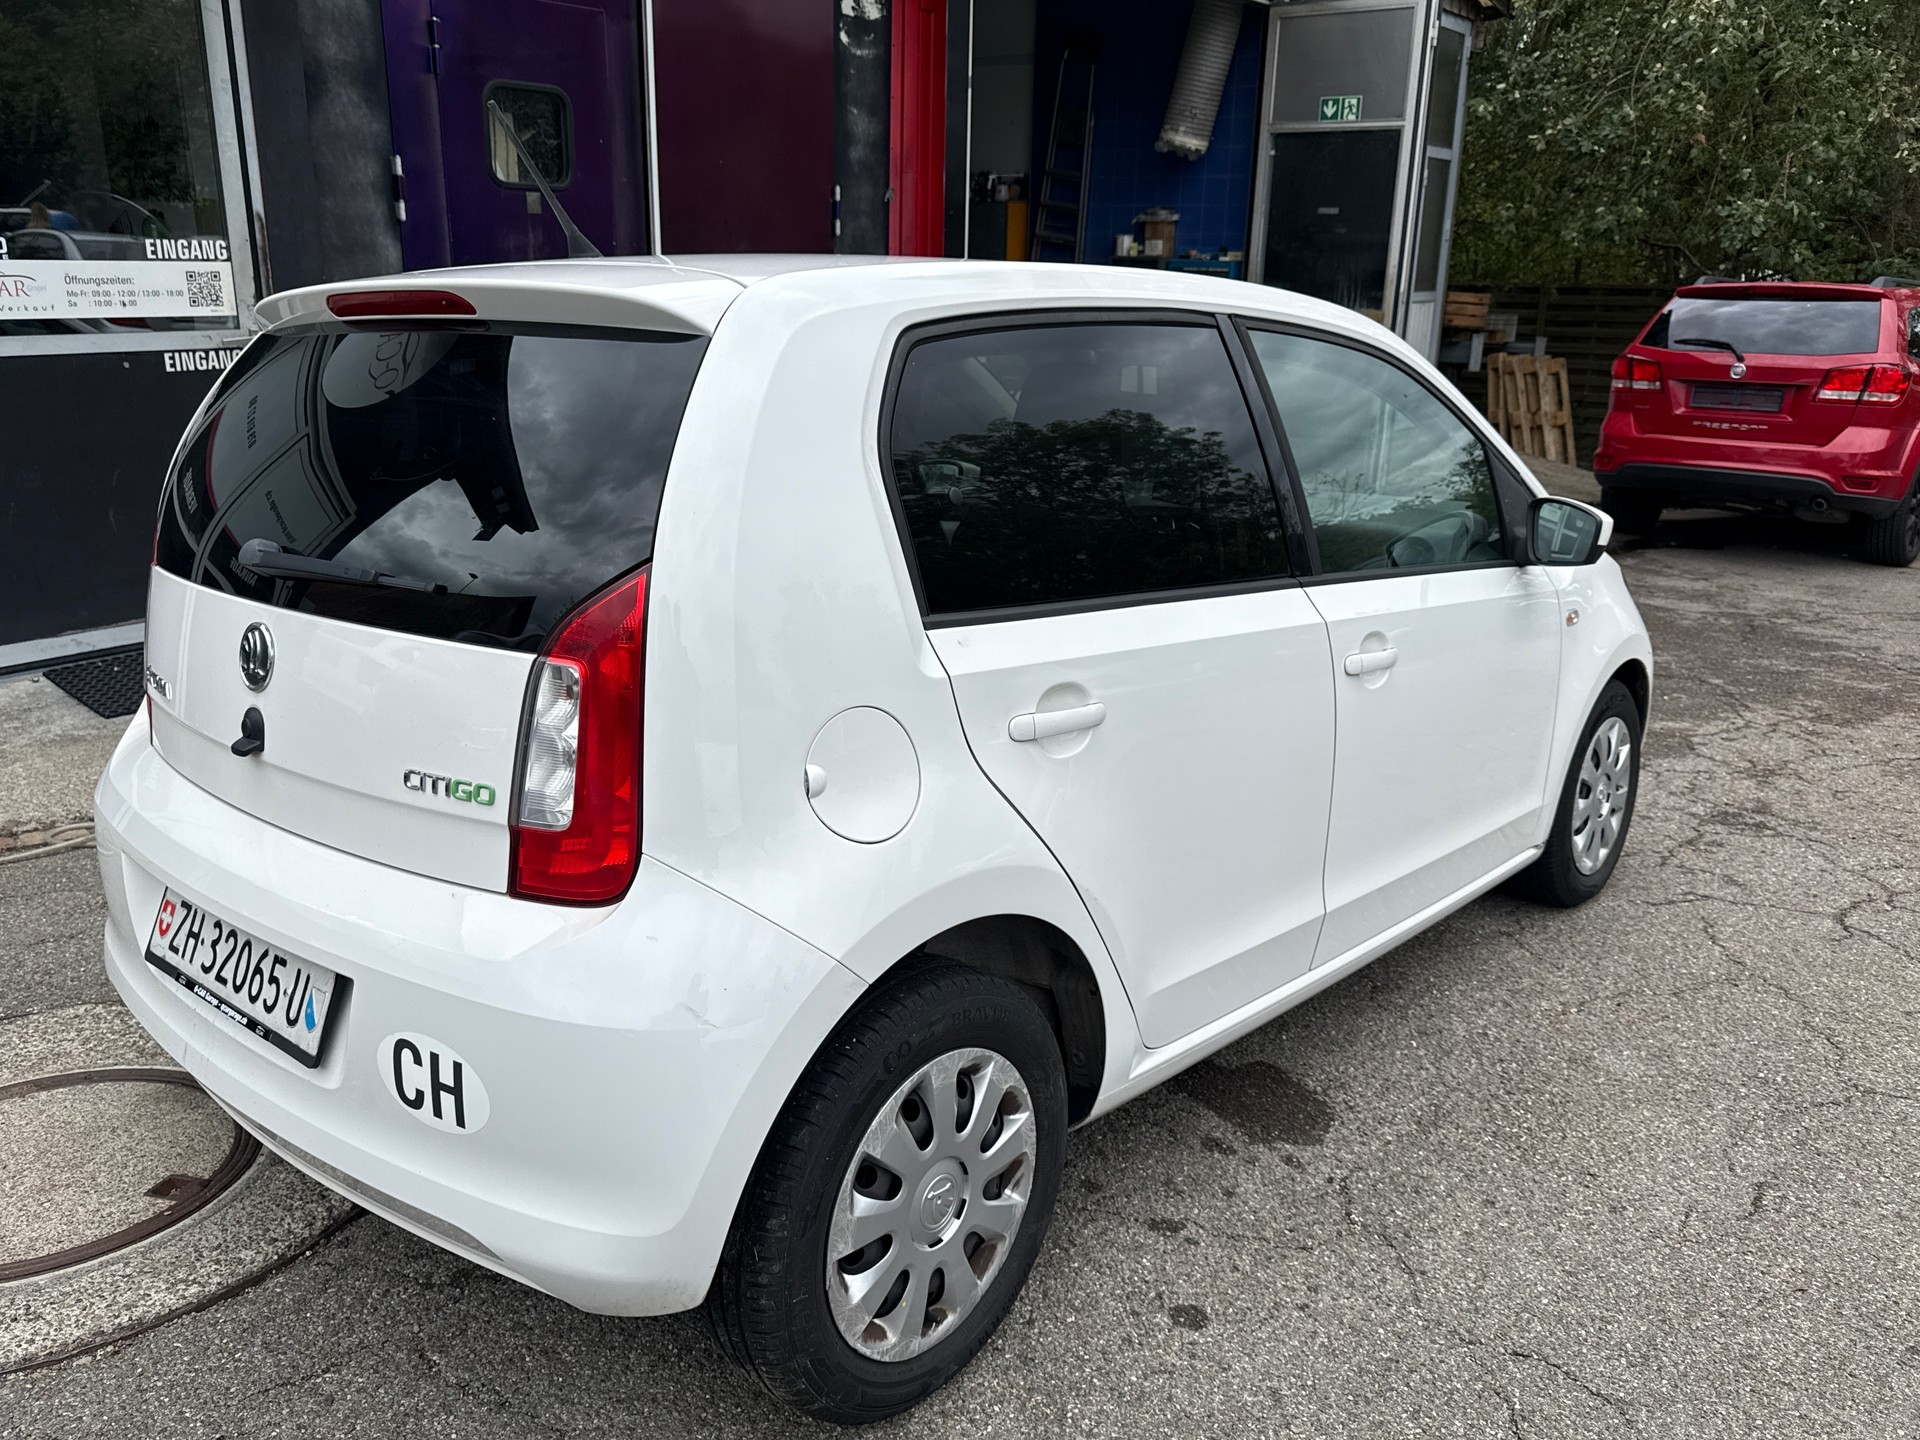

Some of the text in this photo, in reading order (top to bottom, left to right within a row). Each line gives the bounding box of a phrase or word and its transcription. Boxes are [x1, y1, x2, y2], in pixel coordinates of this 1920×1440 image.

[145, 238, 228, 260] EINGANG
[64, 273, 135, 287] Öffnungszeiten:
[403, 768, 496, 807] CITIGO
[393, 1038, 466, 1130] CH
